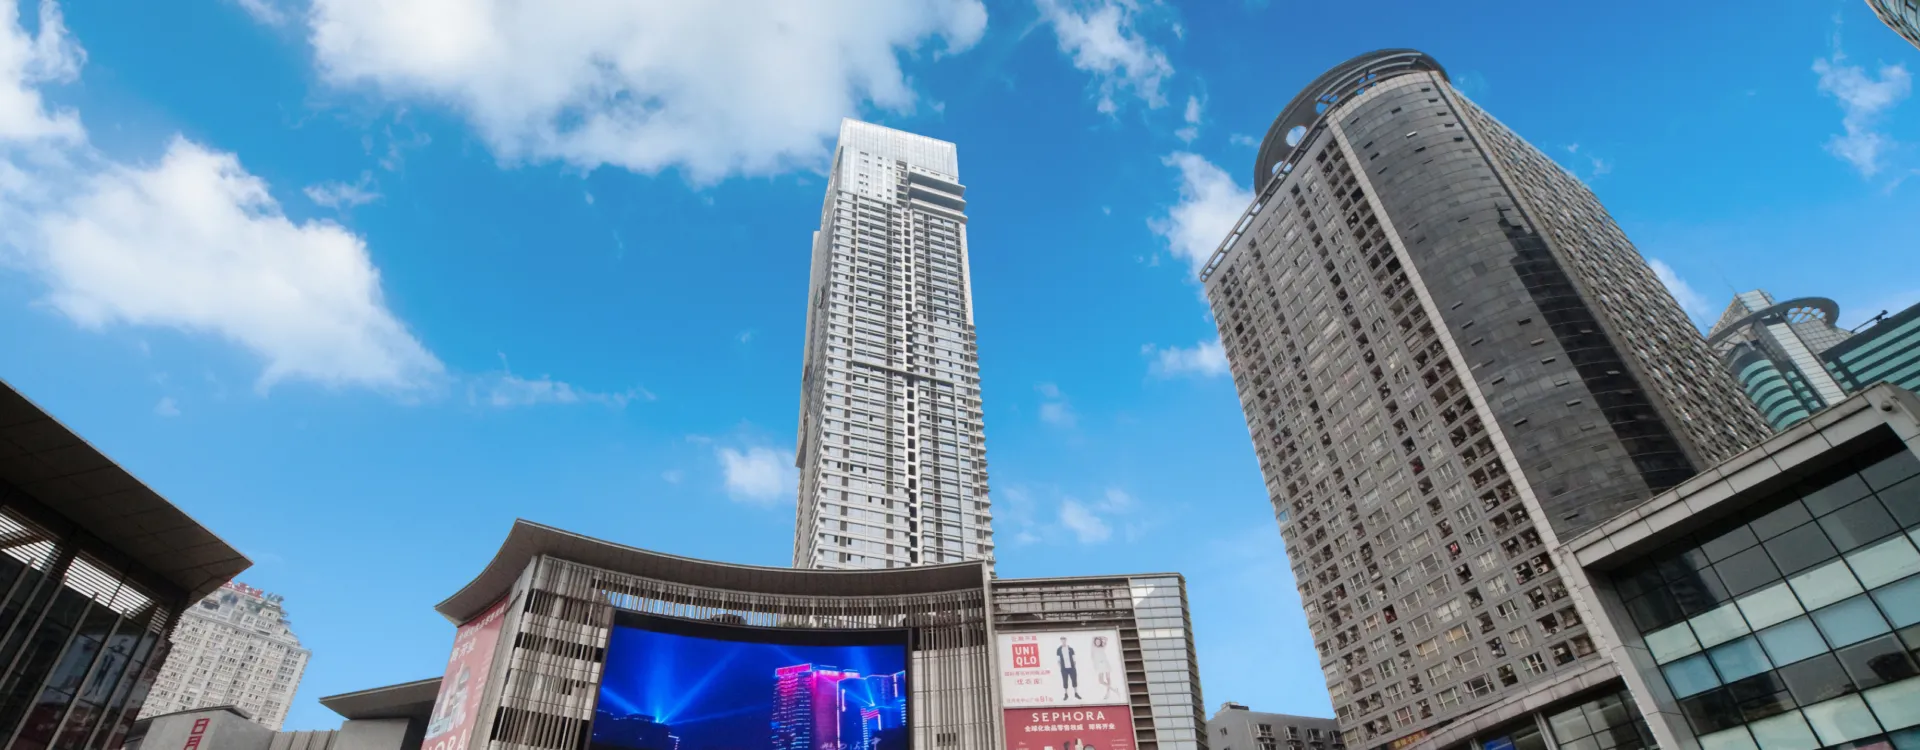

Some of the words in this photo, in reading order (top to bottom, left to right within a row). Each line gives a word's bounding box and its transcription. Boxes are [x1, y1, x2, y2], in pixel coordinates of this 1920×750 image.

[1015, 646, 1034, 655] UNI
[1016, 656, 1037, 666] QLO
[1032, 711, 1106, 722] SEPHORA
